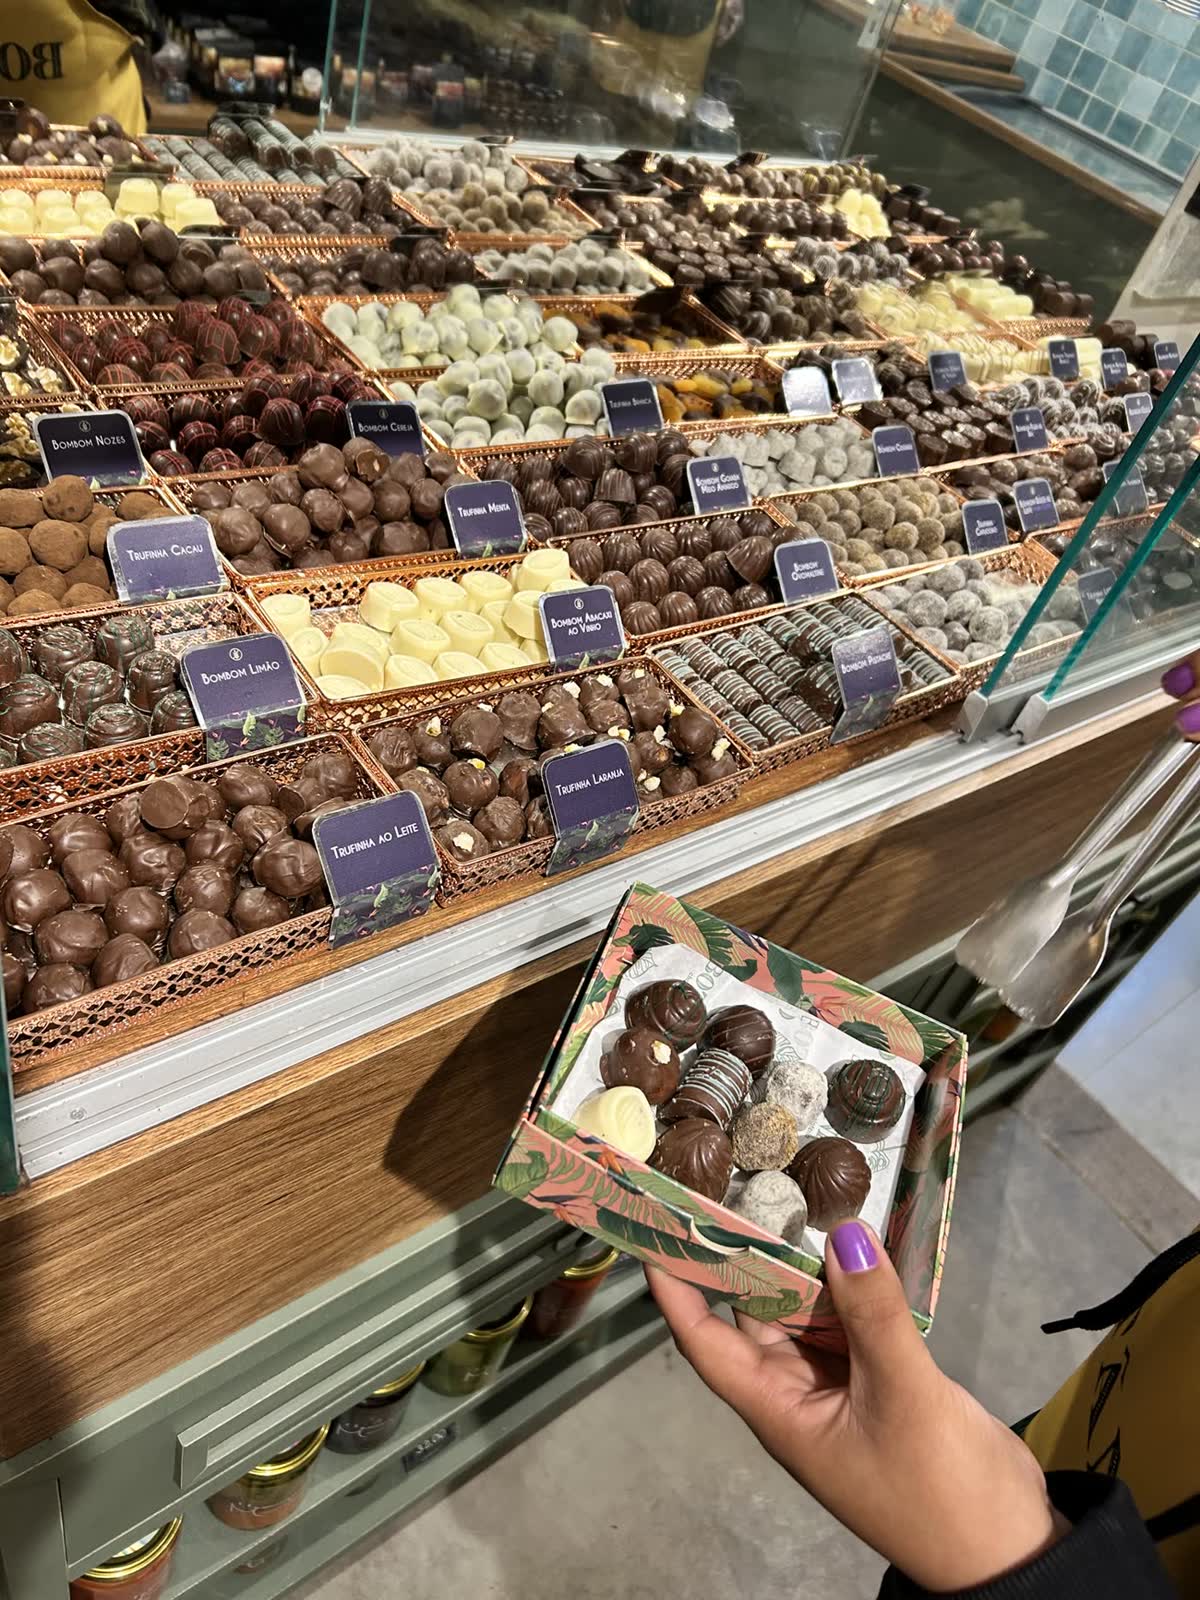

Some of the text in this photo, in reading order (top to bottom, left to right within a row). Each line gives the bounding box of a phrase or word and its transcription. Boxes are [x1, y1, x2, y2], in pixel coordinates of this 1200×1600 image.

[358, 422, 414, 432] BOMBOM CEREJA
[51, 435, 126, 450] BOMBOM NOZES
[457, 501, 511, 518] TRUFINHA MENTA
[126, 544, 204, 561] TRUFINHA CACAU
[551, 611, 613, 629] BOMBOM ABACAXI
[568, 622, 602, 636] AO VINHO
[200, 661, 280, 685] BOMBOM LIMÃO
[555, 768, 625, 796] TRUFINHA LARANJA
[330, 823, 419, 859] TRUFINHA AO LEITE
